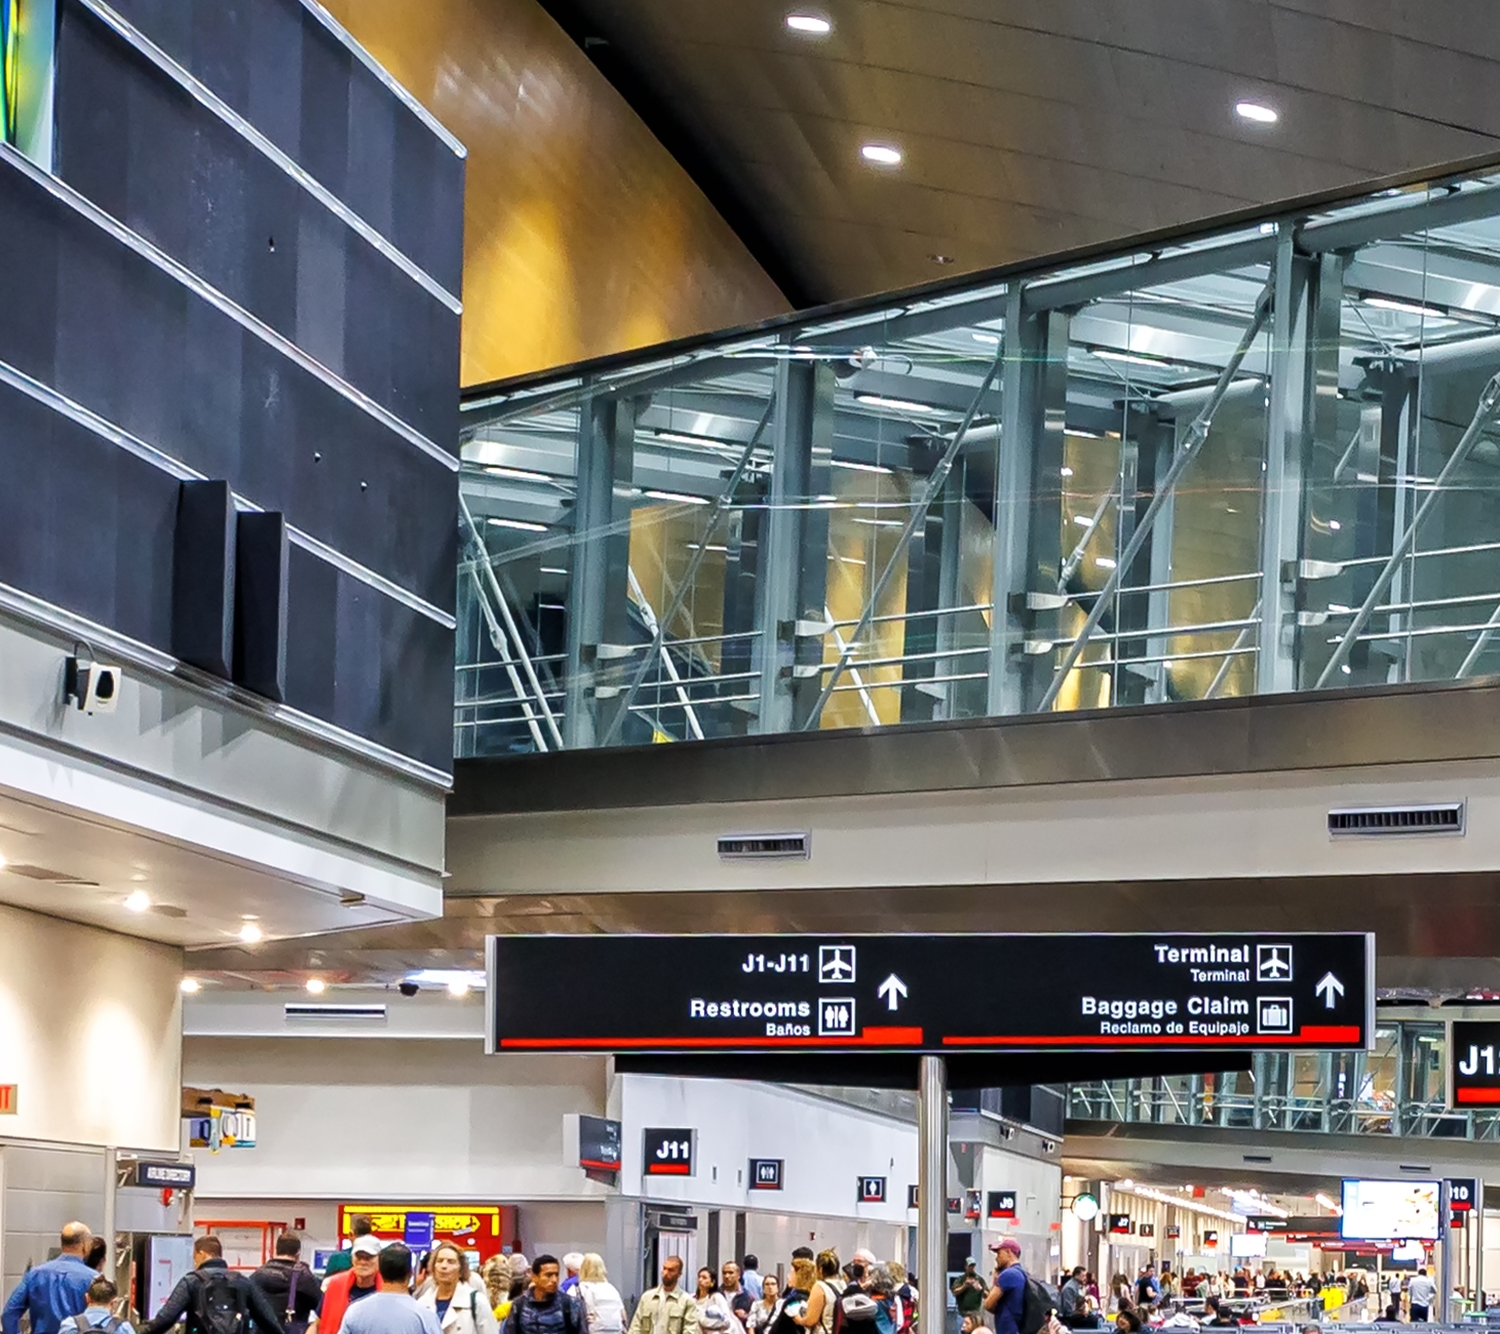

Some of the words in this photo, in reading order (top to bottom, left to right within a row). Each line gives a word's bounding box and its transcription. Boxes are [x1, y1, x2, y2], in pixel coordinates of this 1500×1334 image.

[1153, 943, 1250, 963] Terminal
[742, 953, 809, 973] J1-J11
[1190, 968, 1250, 982] Terminal
[690, 998, 810, 1017] Restrooms
[1081, 996, 1178, 1019] Baggage
[1187, 996, 1249, 1015] Claim
[766, 1022, 811, 1036] Baños
[1100, 1021, 1162, 1034] Reclamo
[1166, 1021, 1184, 1034] de
[1188, 1021, 1250, 1036] Equipaje
[656, 1140, 690, 1159] J11
[1449, 1186, 1469, 1200] 10
[999, 1197, 1014, 1209] J9
